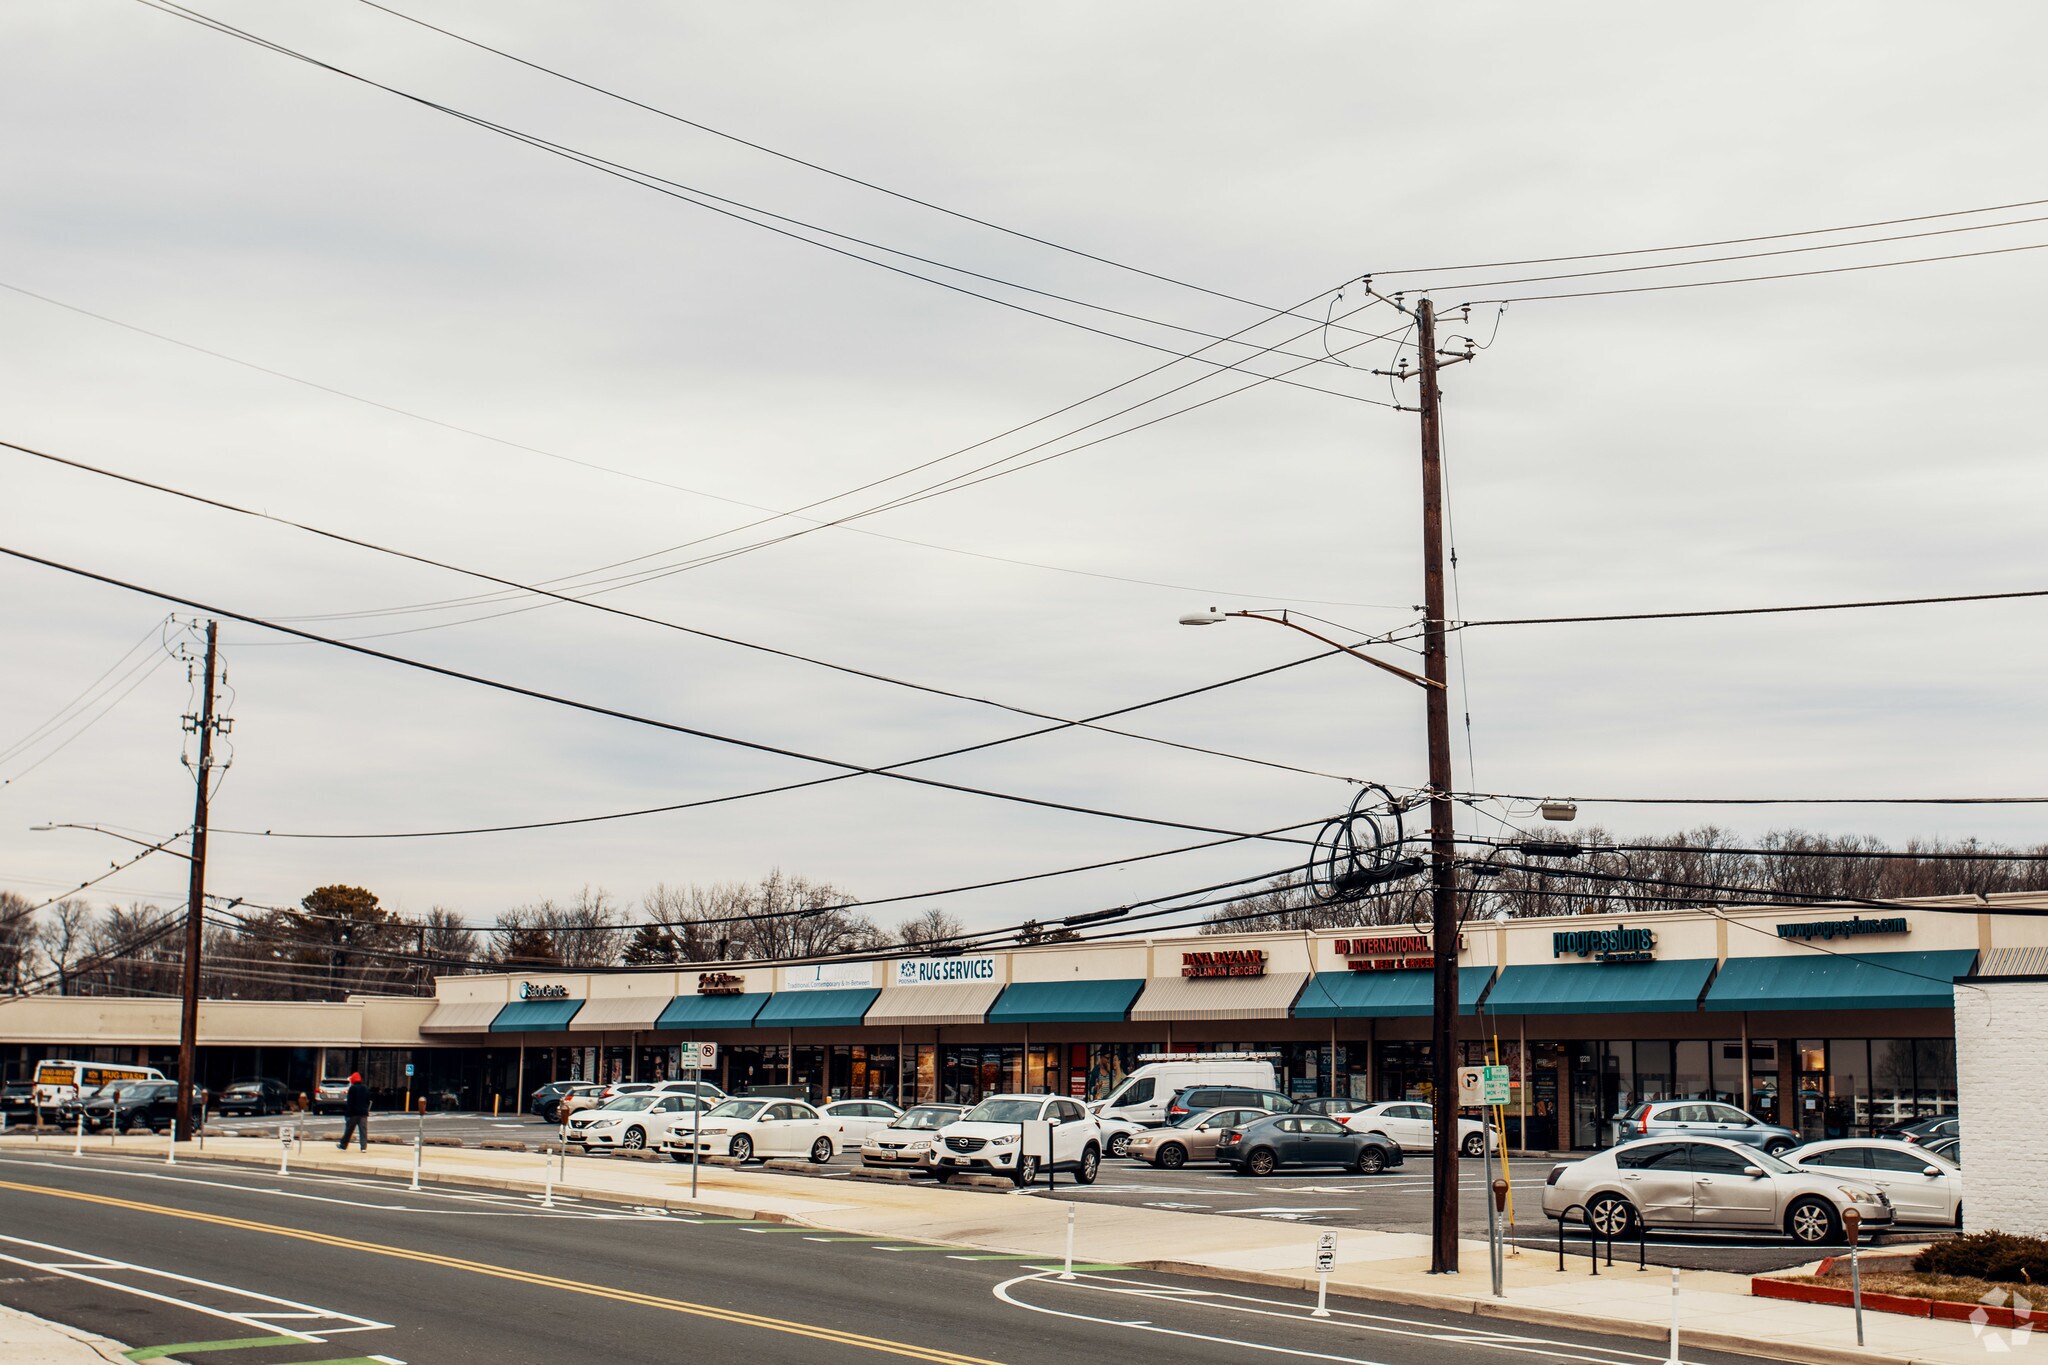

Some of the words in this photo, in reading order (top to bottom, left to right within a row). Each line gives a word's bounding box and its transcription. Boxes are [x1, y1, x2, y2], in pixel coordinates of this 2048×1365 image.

[1352, 936, 1430, 953] INTERNATIONAL
[1553, 924, 1653, 958] progressions
[1182, 952, 1212, 965] DANA
[1213, 950, 1262, 965] BAZAAR
[1374, 960, 1395, 970] MEAT
[1405, 958, 1435, 968] GROCER
[920, 962, 940, 980] RUG
[943, 959, 993, 979] SERVICES
[1182, 967, 1227, 977] INDO-LANKAN
[1229, 965, 1262, 976] GROCERY
[102, 1071, 145, 1081] RUG-WASH
